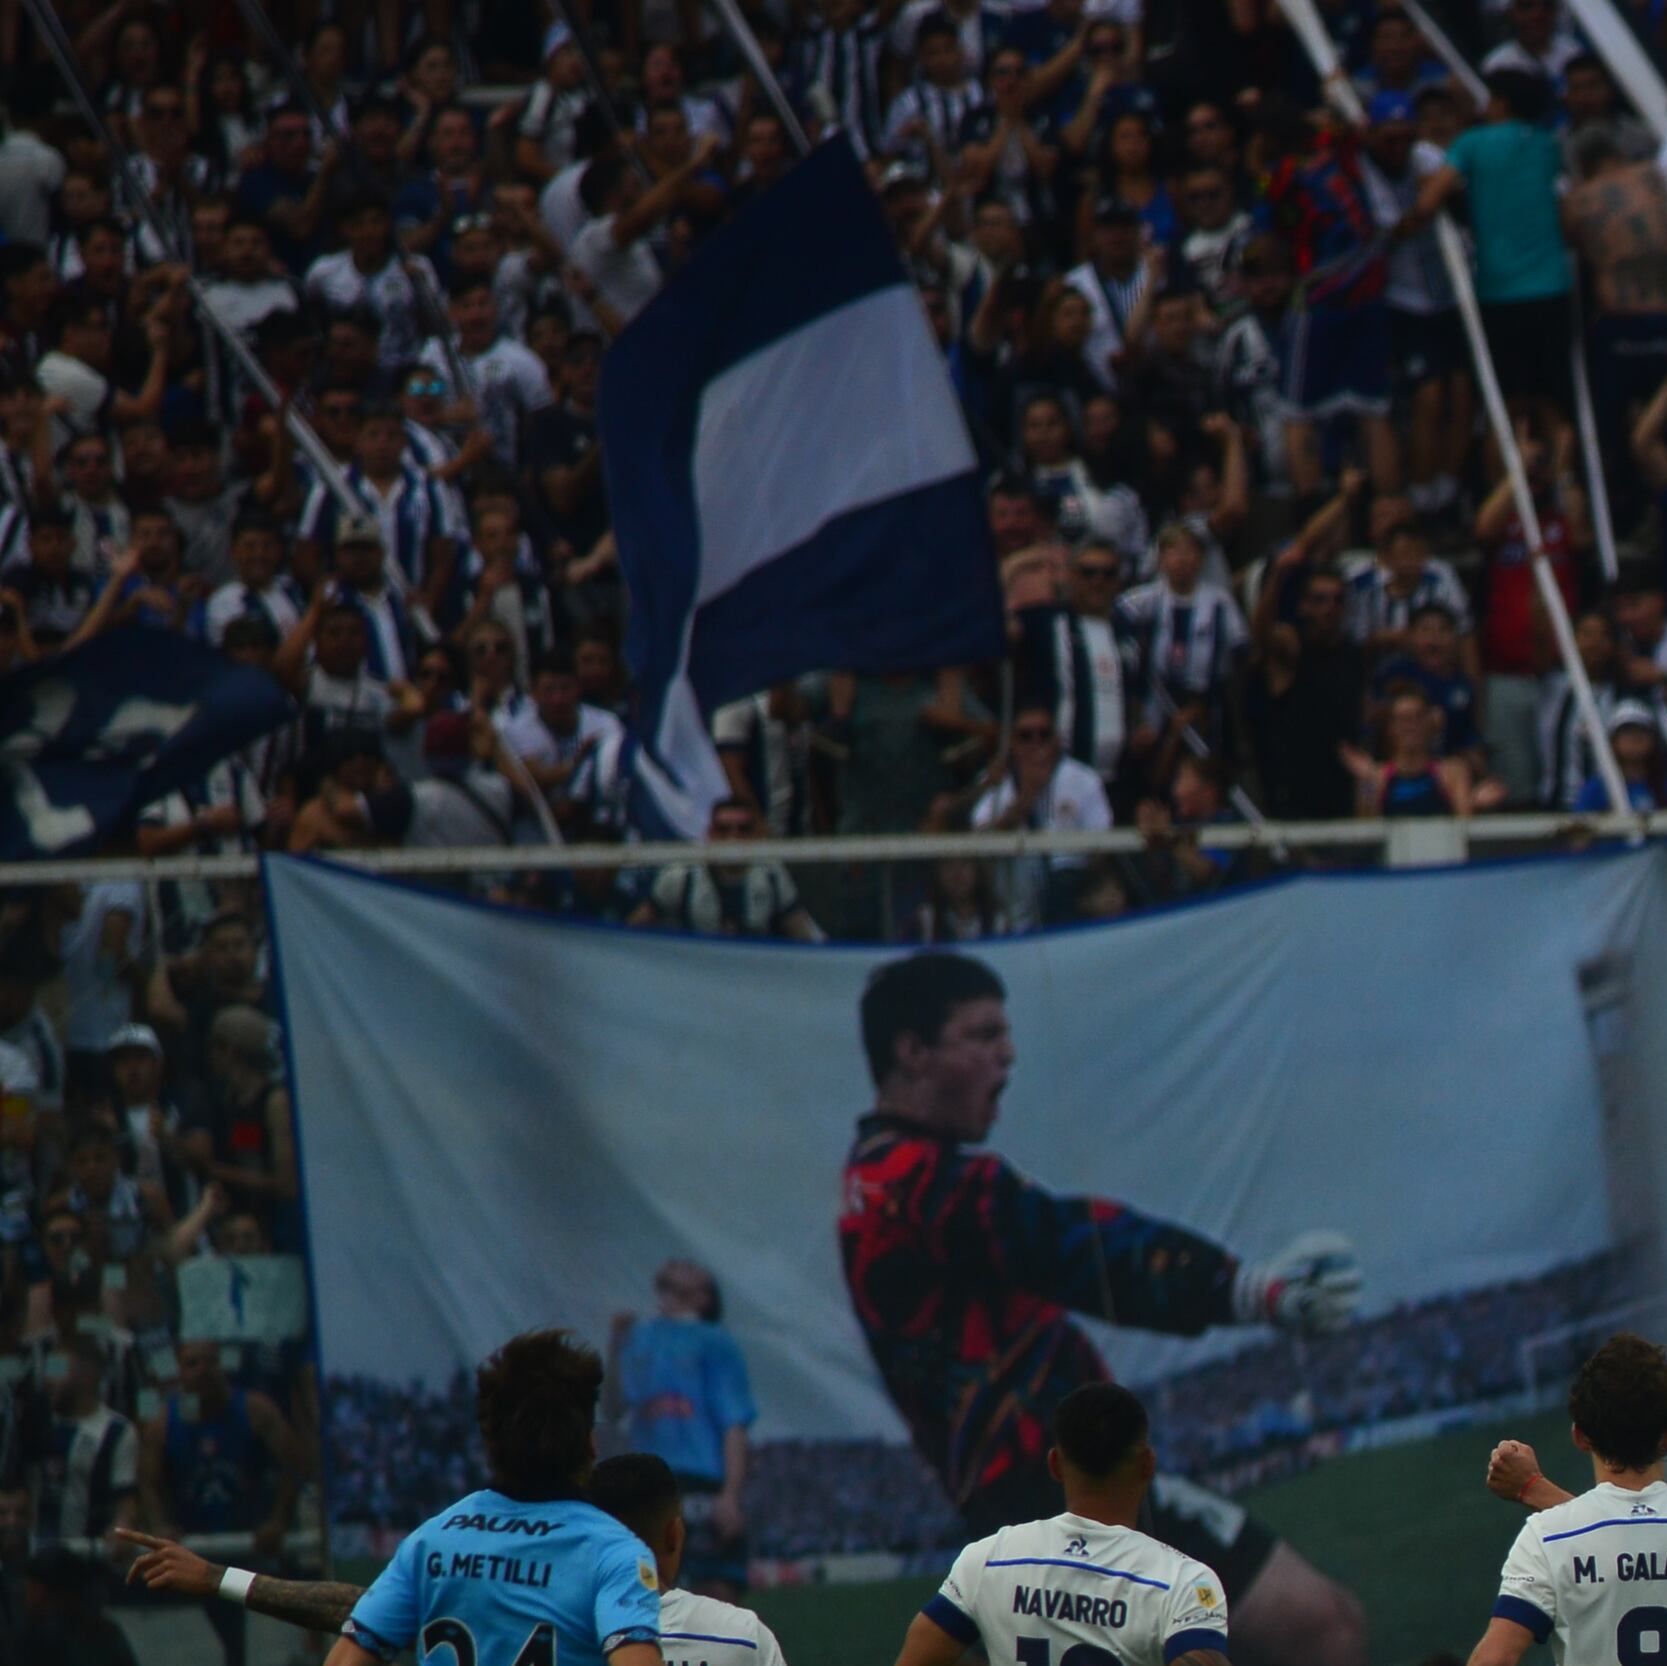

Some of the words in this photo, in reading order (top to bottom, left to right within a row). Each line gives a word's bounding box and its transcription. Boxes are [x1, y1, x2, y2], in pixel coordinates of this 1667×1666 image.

[442, 1513, 566, 1536] PAUNY
[427, 1552, 447, 1578] G.
[451, 1552, 552, 1588] METILLI
[1574, 1555, 1605, 1584] M.
[1013, 1585, 1128, 1629] NAVARRO
